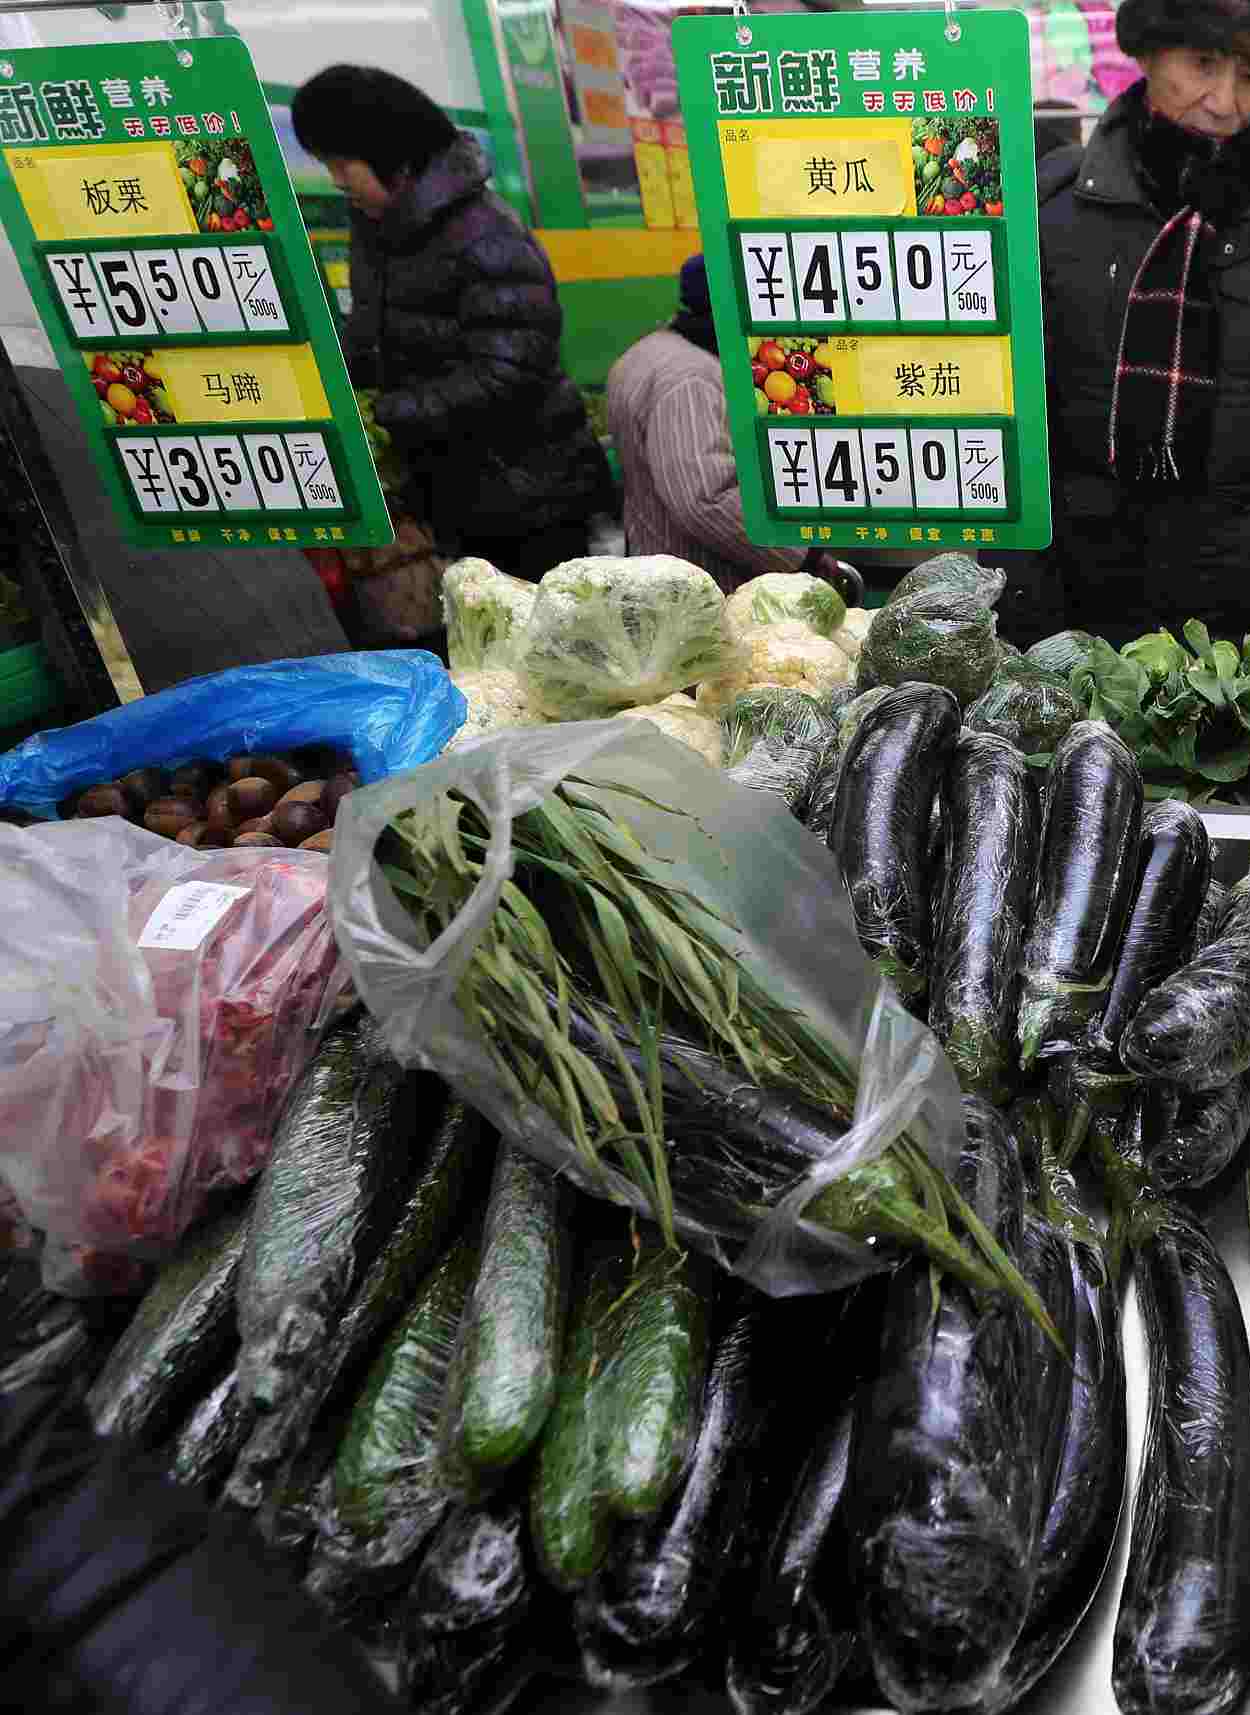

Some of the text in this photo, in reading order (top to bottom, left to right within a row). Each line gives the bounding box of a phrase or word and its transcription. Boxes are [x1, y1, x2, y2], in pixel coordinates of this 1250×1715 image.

[848, 48, 927, 81] 营养
[99, 77, 173, 110] 营养
[804, 157, 875, 196] 黄瓜
[80, 177, 149, 215] 板栗
[203, 372, 262, 405] 马蹄
[895, 362, 961, 399] 紫茄
